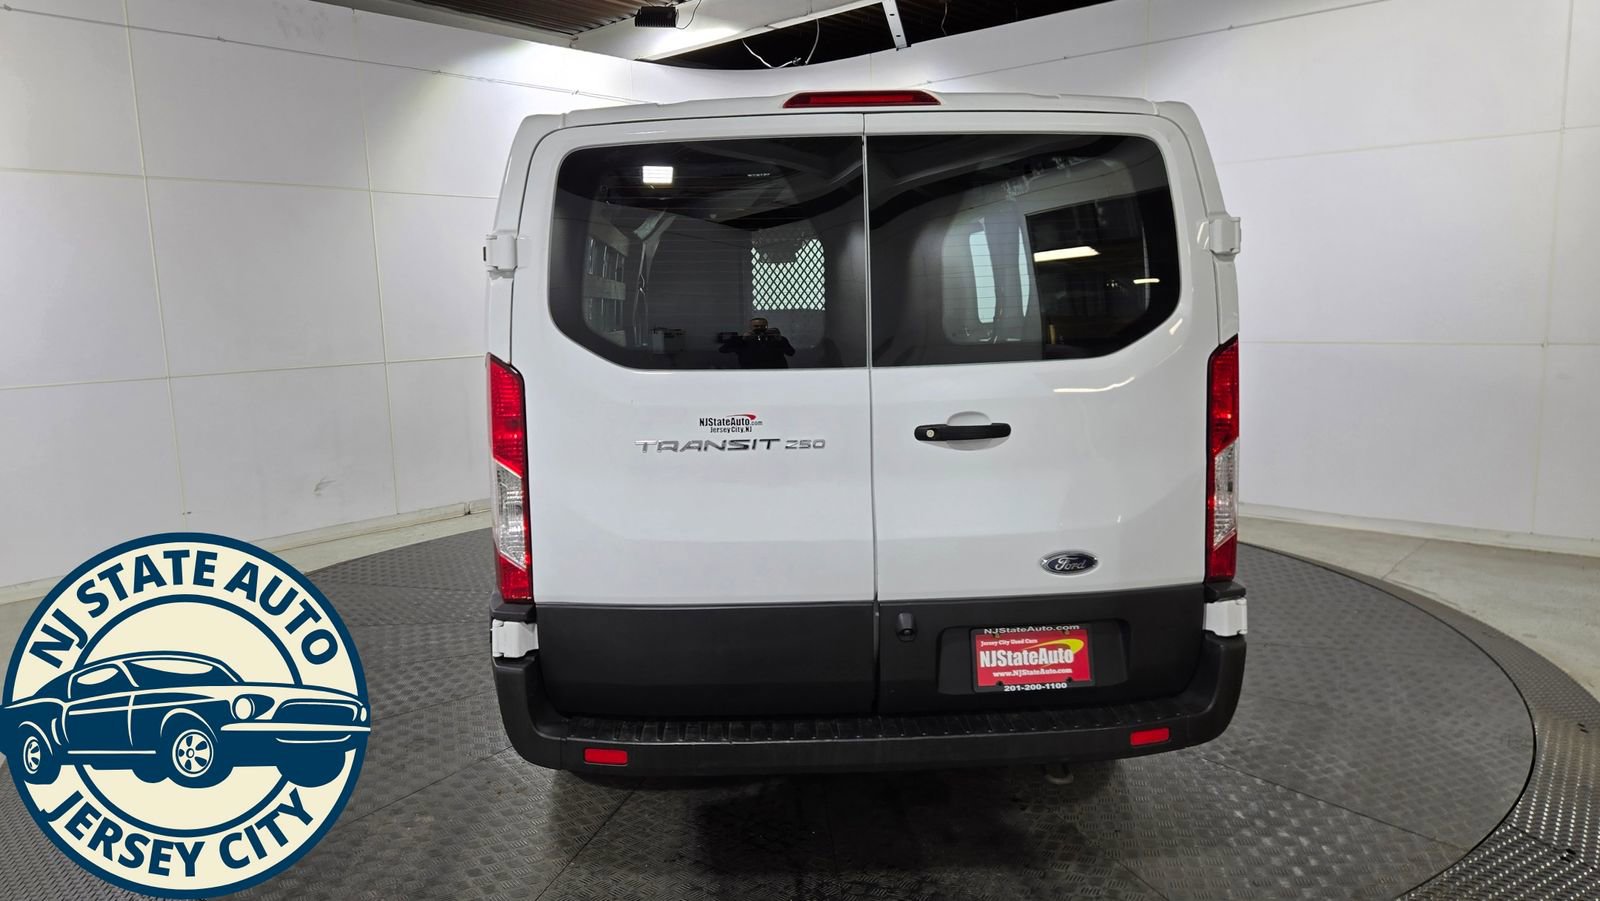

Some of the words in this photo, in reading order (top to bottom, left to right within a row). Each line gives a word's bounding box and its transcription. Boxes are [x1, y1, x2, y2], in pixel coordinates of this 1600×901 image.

[699, 417, 763, 427] NJStateAuto.com
[633, 438, 781, 453] TRANSIT
[785, 439, 826, 450] 250
[1055, 556, 1087, 571] Ford
[983, 624, 1080, 635] NJStateAuto.com
[979, 647, 1074, 668] NJStateAuto
[992, 667, 1073, 678] www.NJStateAuto.com
[1003, 682, 1068, 692] 201-200-1100
